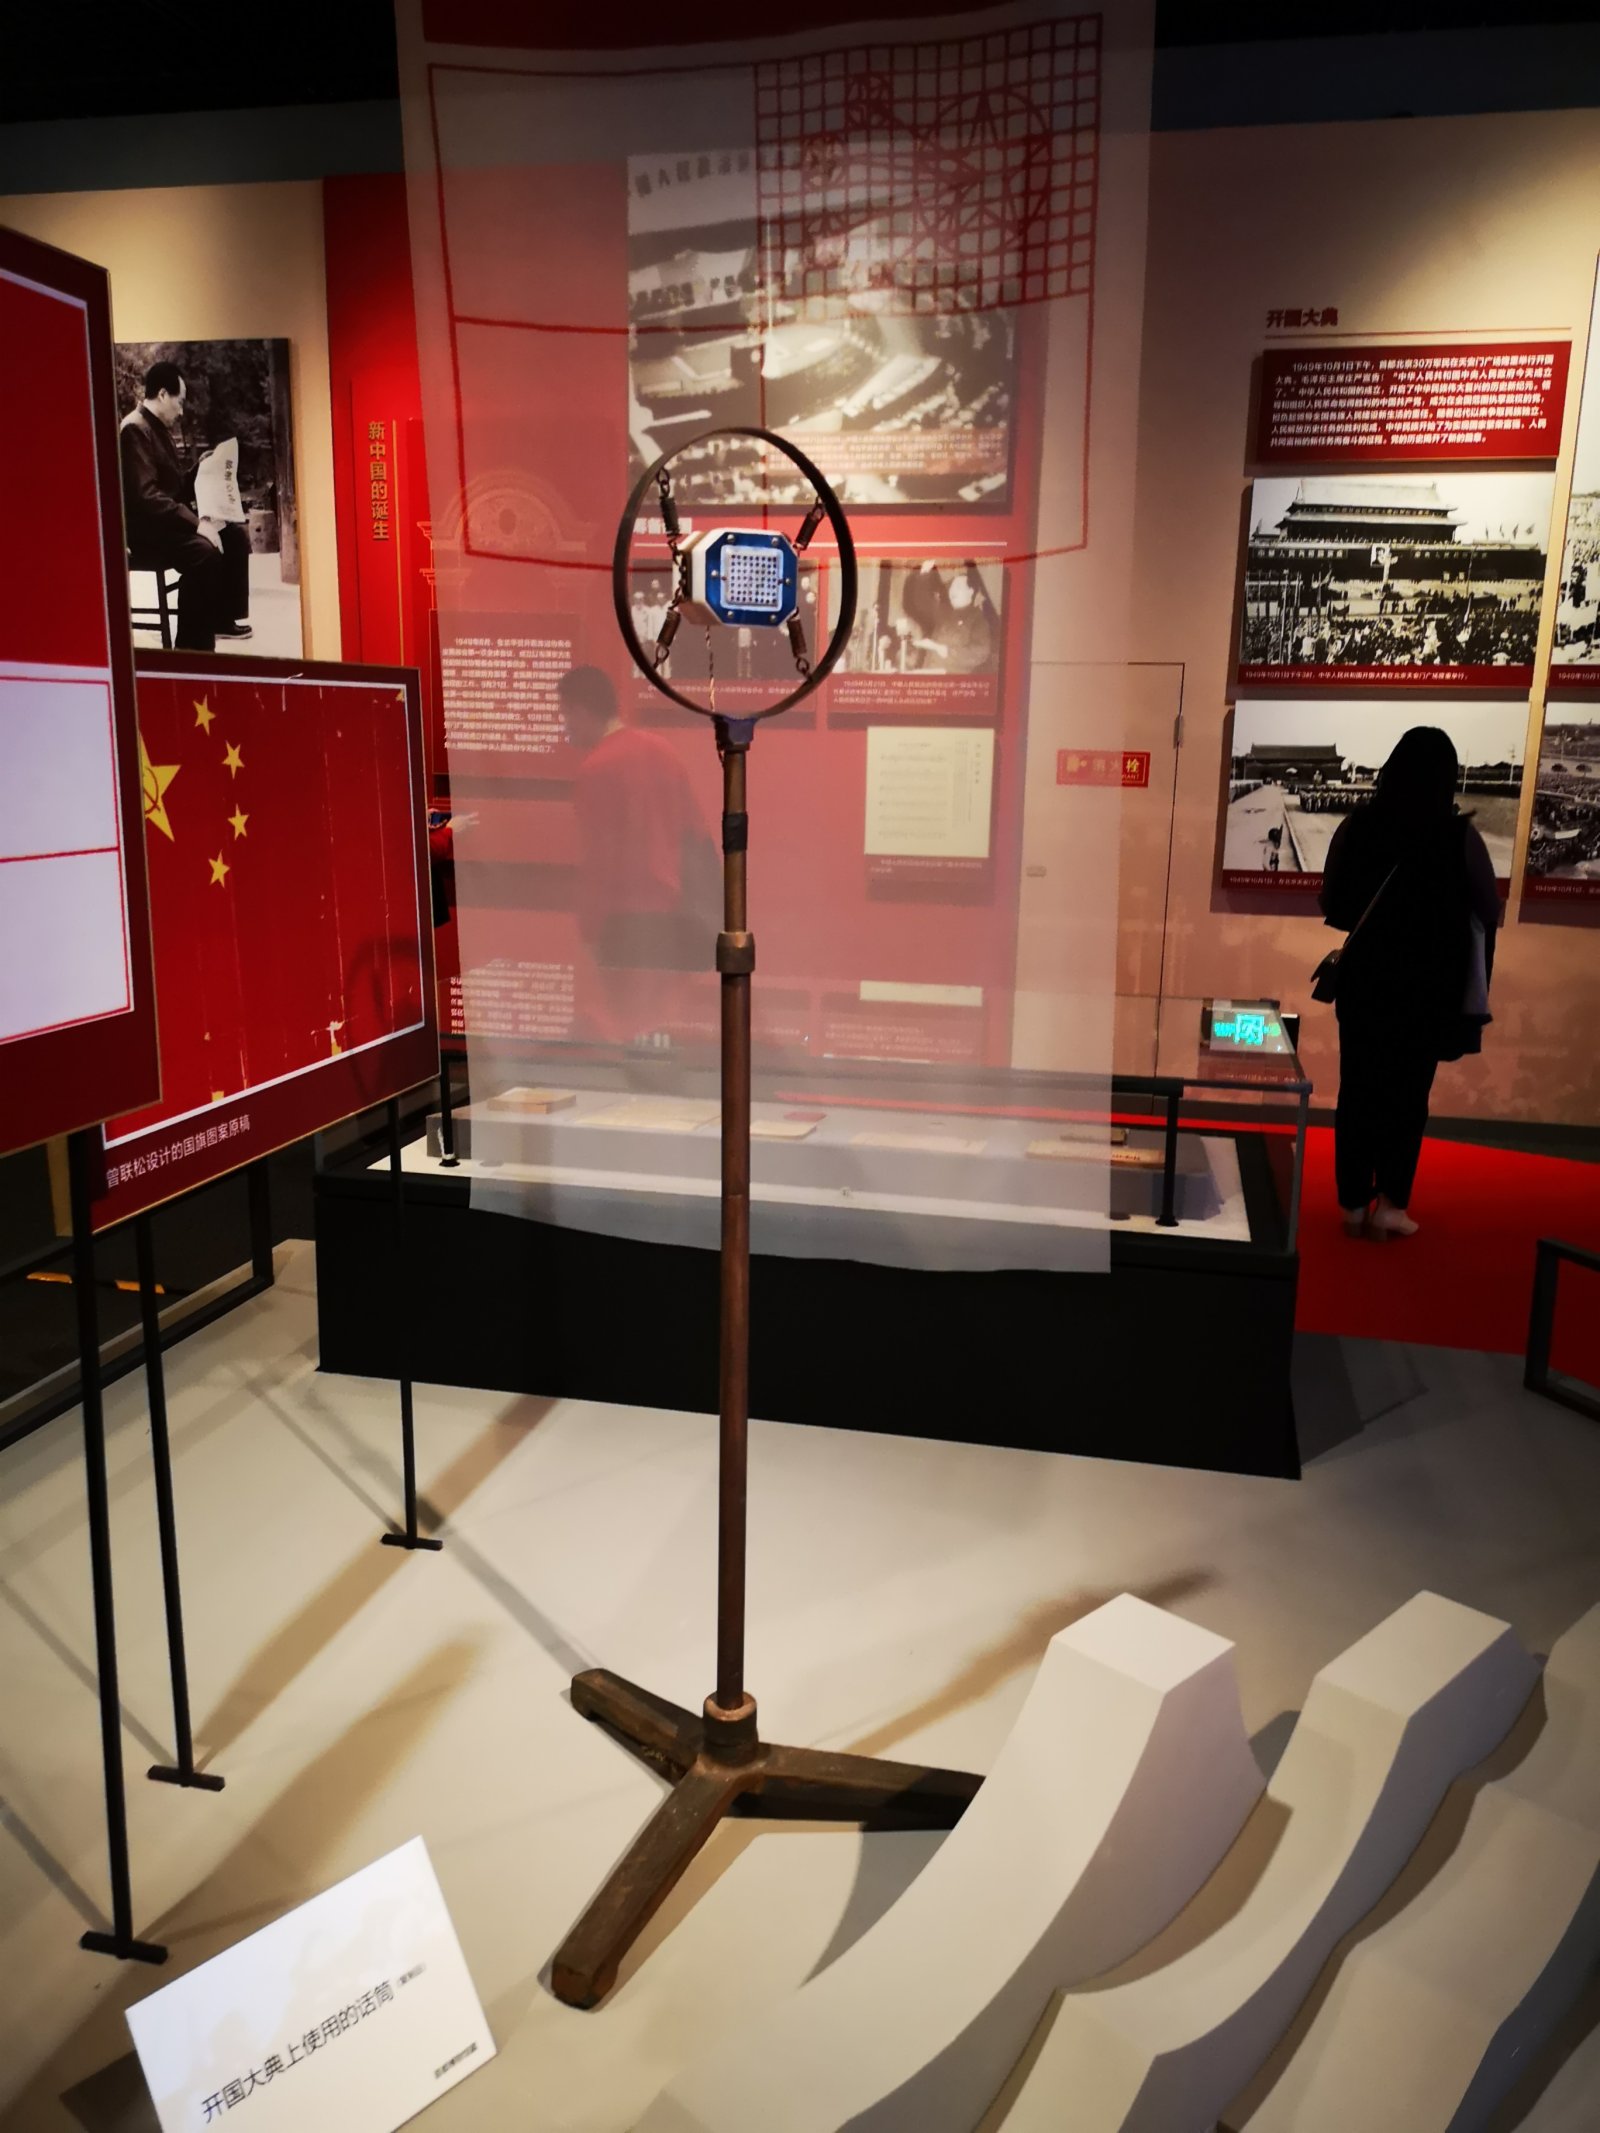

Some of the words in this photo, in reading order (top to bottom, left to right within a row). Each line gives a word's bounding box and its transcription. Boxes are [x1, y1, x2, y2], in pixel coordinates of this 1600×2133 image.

[368, 421, 390, 540] 新中国的诞生
[106, 1114, 250, 1189] 曾联松设计的国旗图案原稿
[201, 1980, 394, 2124] 开国大典上使用的话筒
